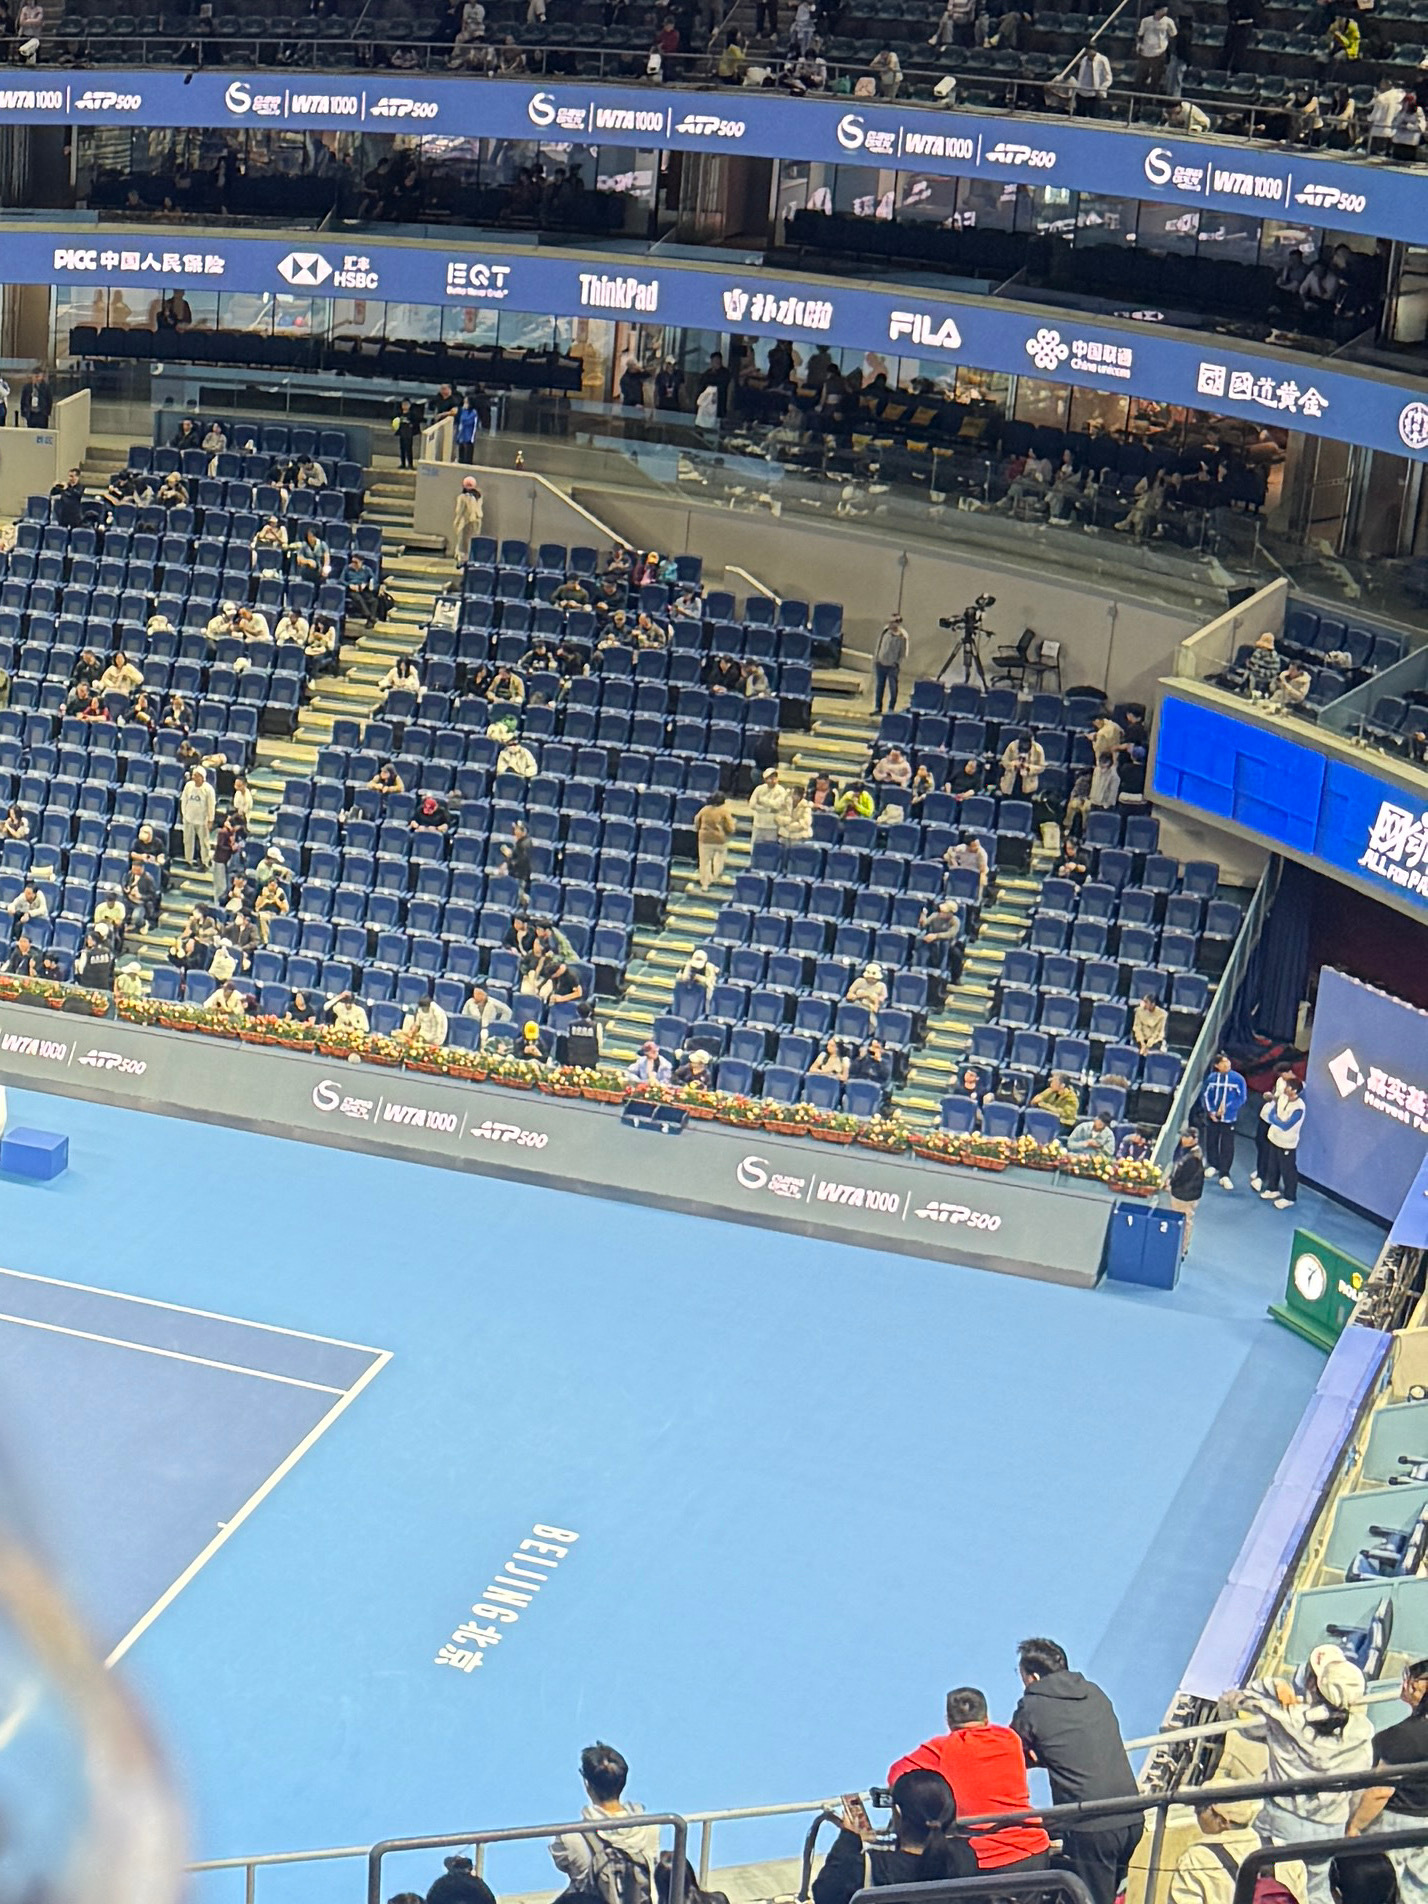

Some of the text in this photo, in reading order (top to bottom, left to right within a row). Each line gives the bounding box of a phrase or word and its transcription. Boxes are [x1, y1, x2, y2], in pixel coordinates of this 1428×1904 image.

[54, 250, 225, 273] PICC 中国人民保险
[448, 263, 510, 287] EQT
[334, 271, 378, 289] HSBC
[579, 274, 658, 311] ThinkPad
[890, 312, 961, 348] FILA
[434, 1524, 579, 1672] BEIJING 北京
